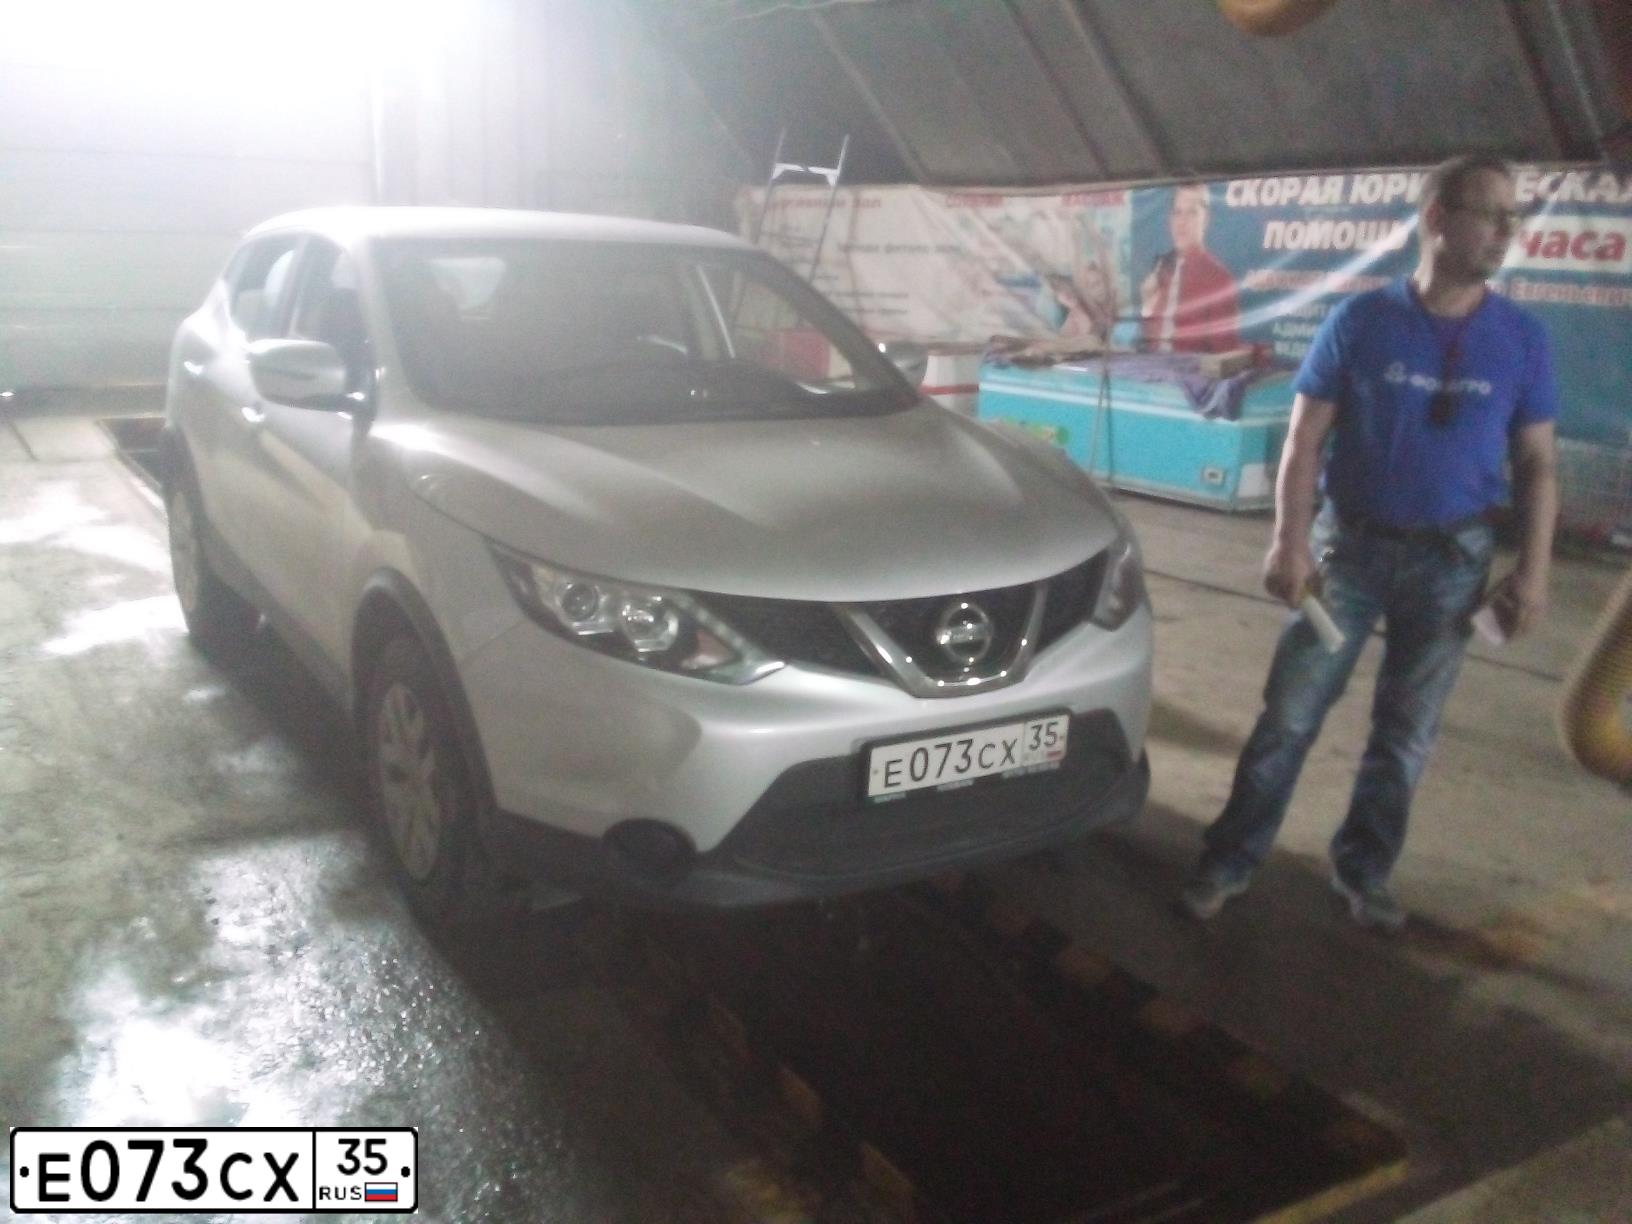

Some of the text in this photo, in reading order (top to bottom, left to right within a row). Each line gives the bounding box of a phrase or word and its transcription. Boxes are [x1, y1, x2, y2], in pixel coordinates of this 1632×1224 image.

[1226, 175, 1345, 207] СКОРАЯ
[1522, 229, 1627, 262] часа
[1029, 721, 1059, 751] 35
